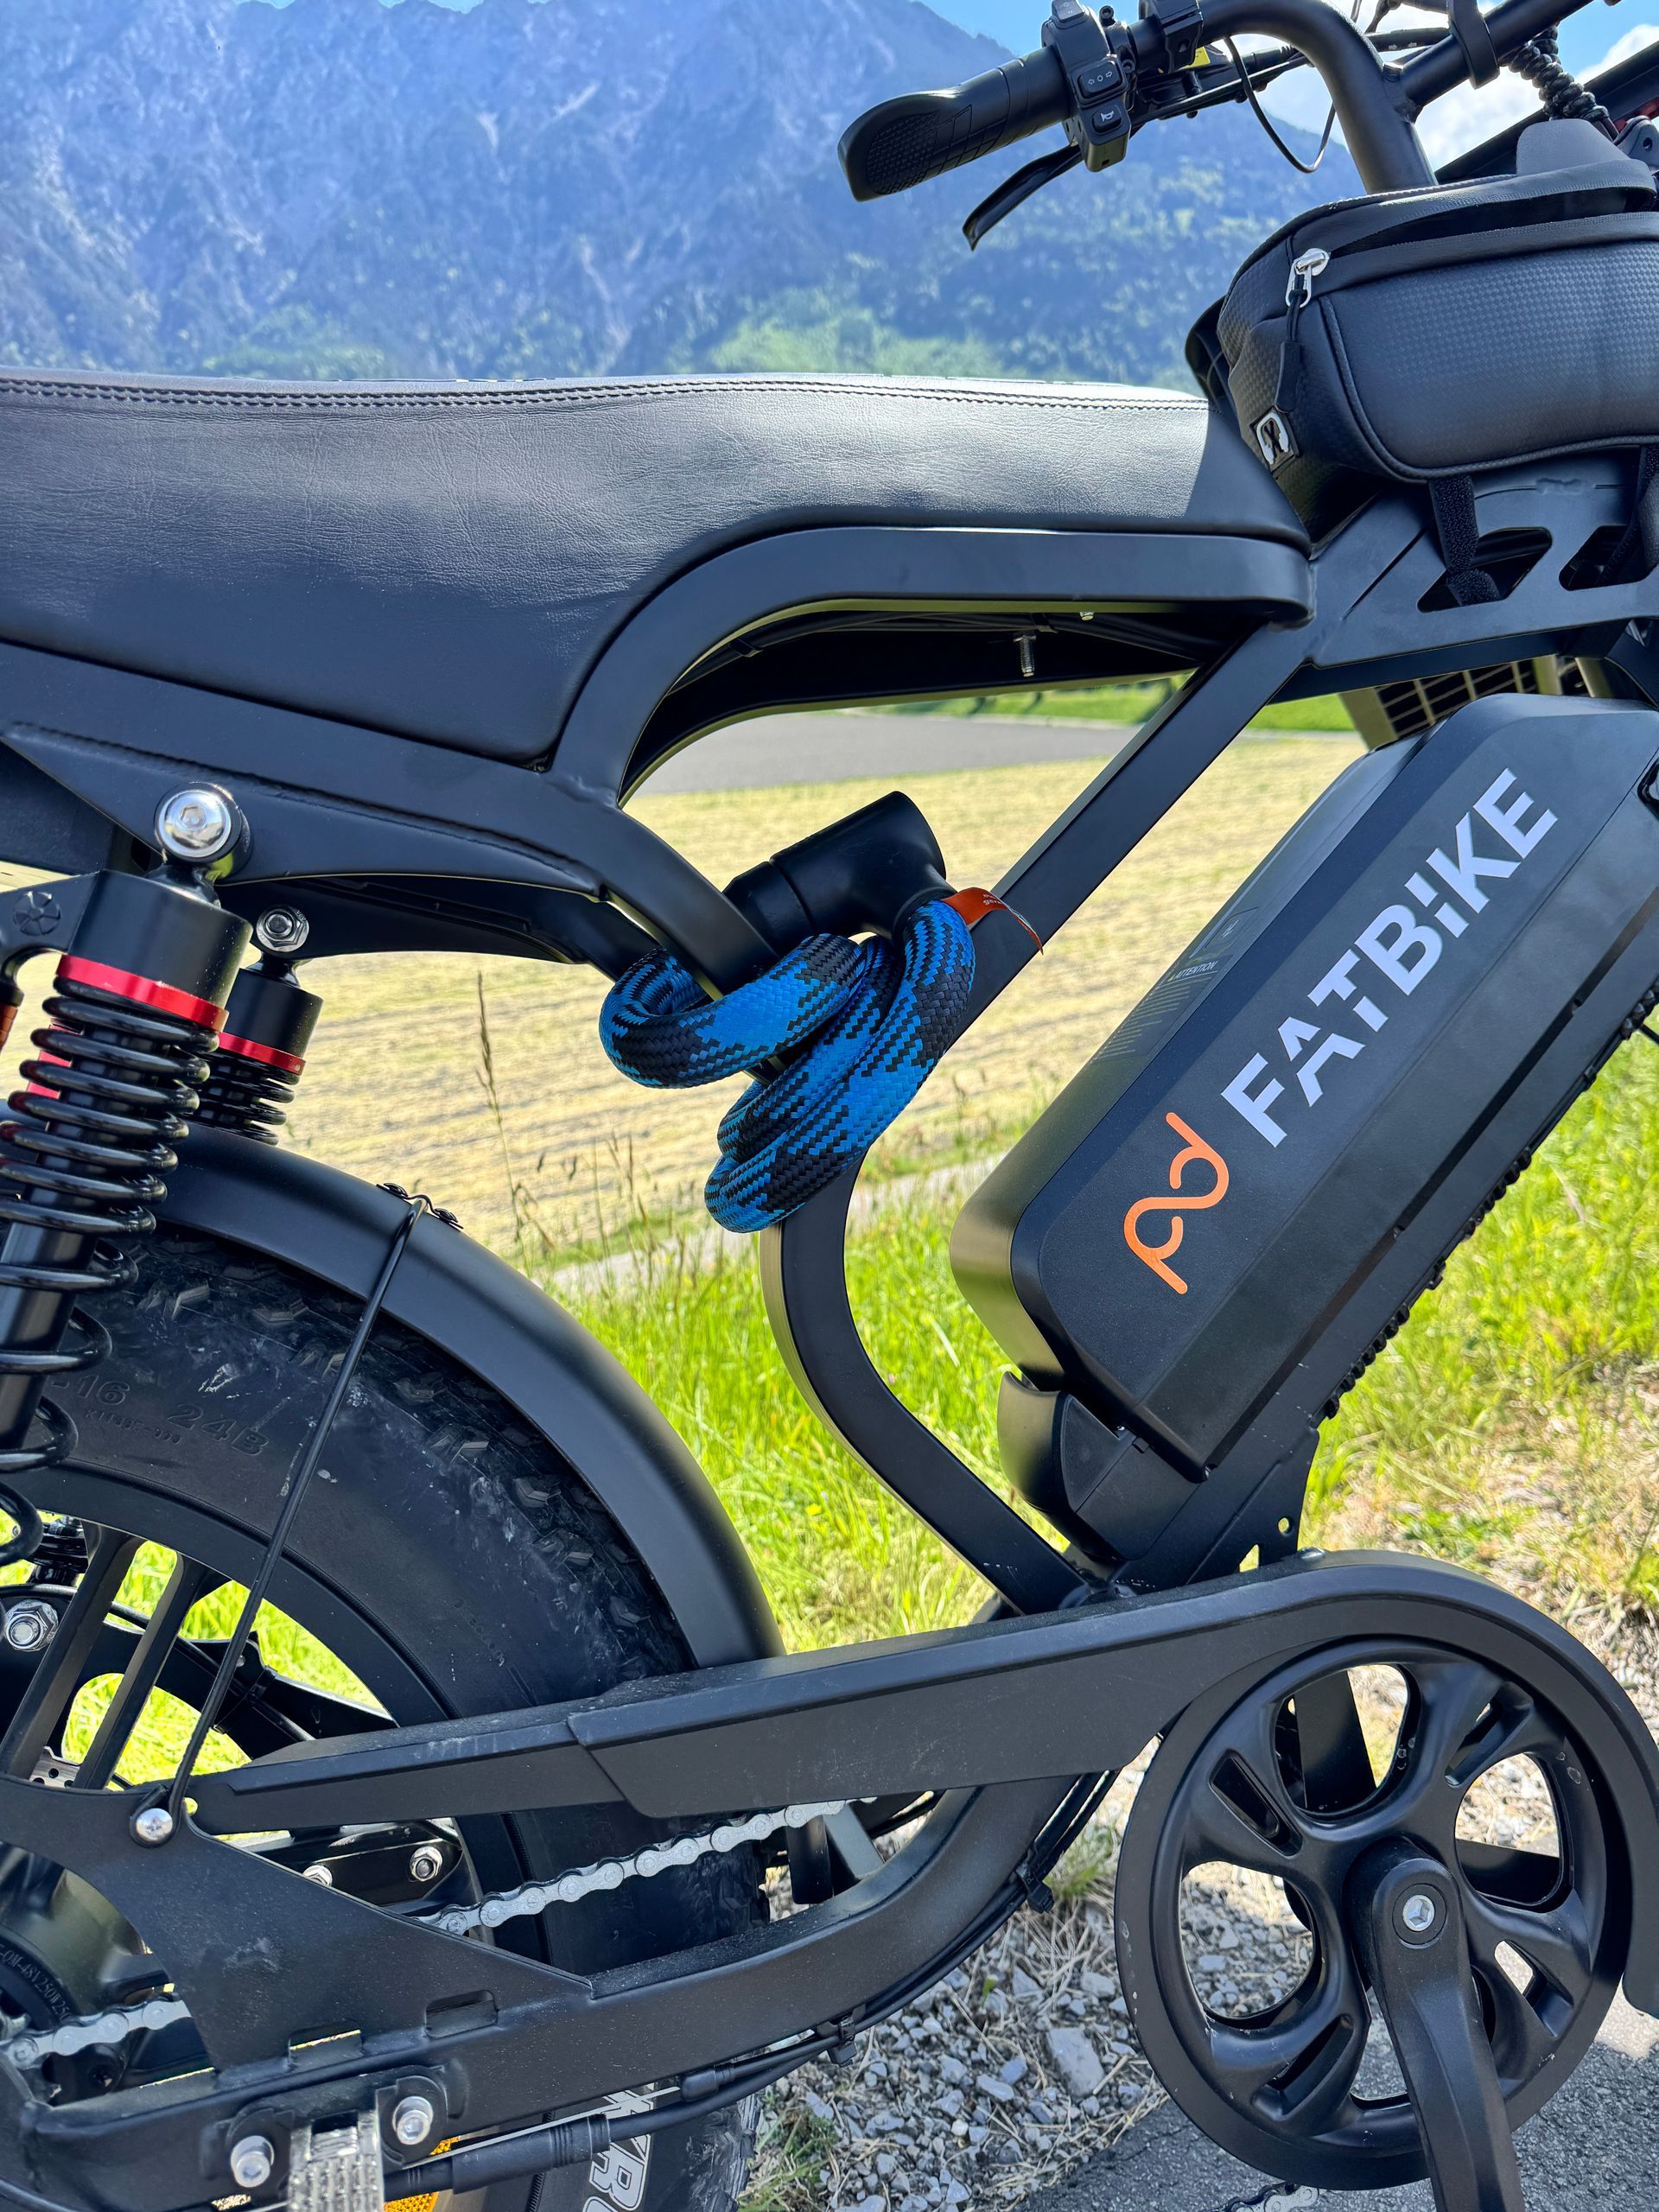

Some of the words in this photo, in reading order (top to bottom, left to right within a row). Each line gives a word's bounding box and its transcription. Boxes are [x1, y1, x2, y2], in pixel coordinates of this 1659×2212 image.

[1173, 960, 1218, 980] ATTENTION
[1220, 767, 1558, 1147] FATBIKE
[167, 1403, 269, 1456] 24B
